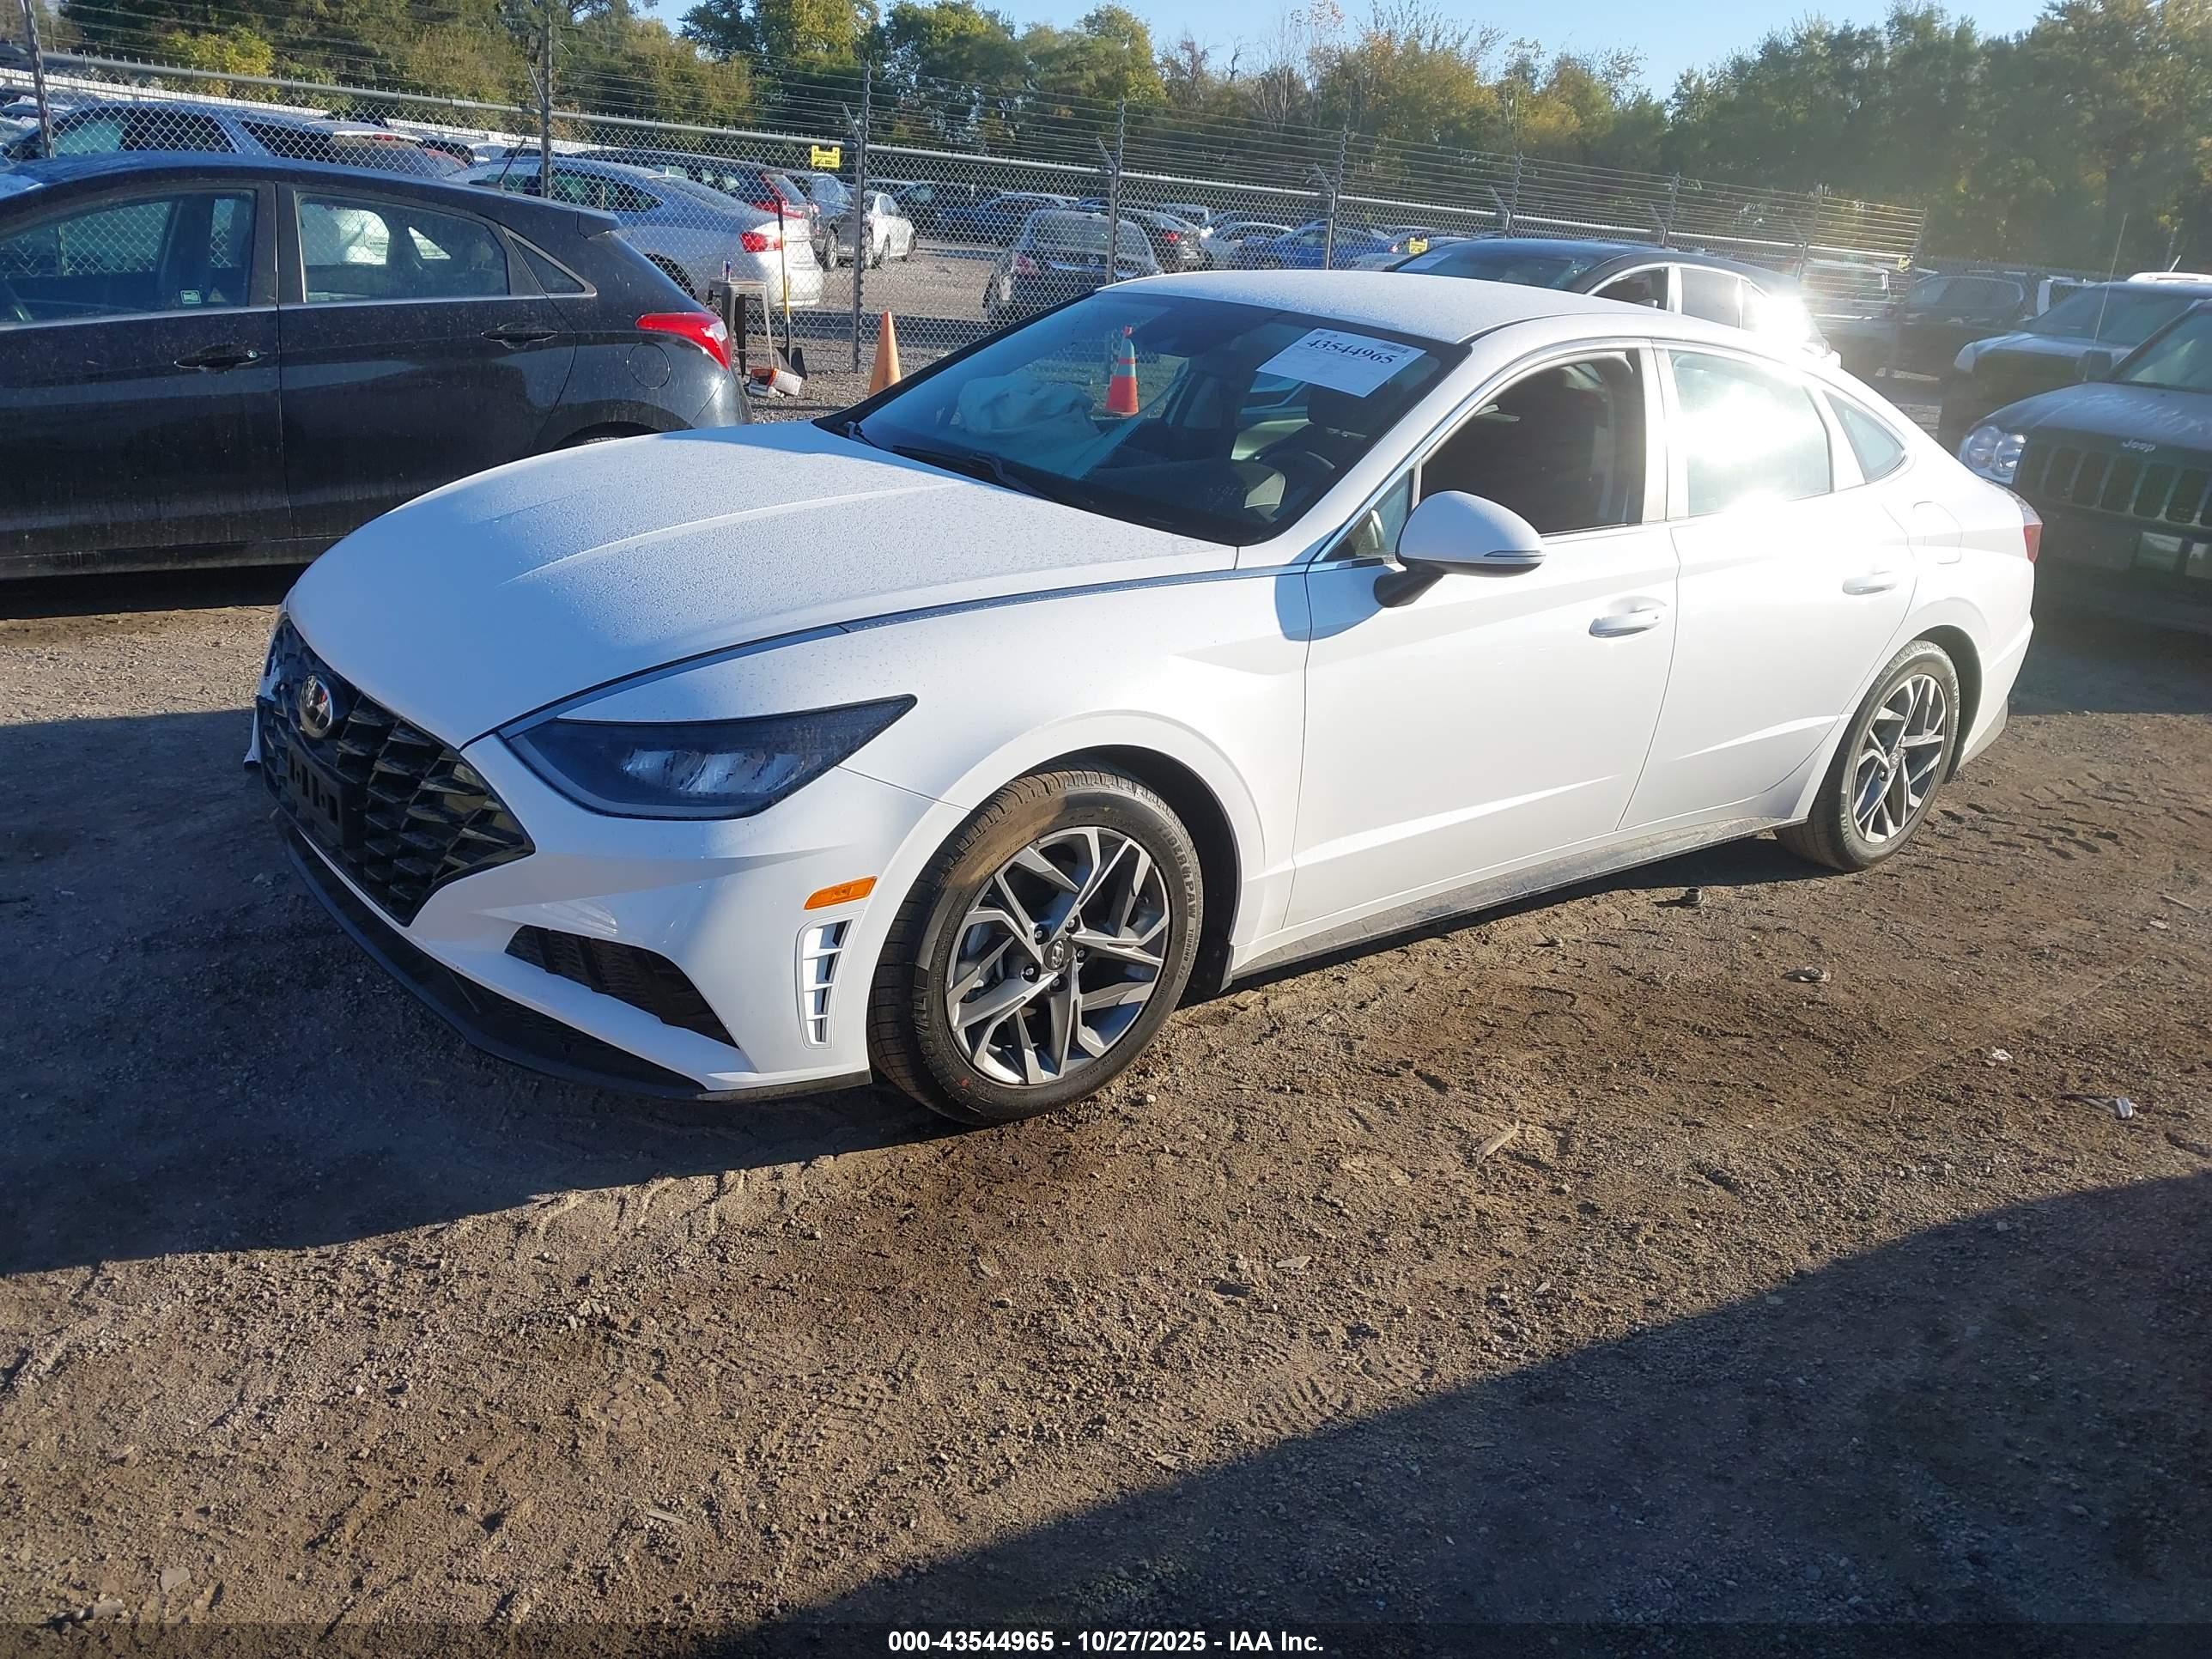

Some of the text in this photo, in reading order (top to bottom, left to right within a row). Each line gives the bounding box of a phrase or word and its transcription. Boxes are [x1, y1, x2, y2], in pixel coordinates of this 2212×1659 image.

[1307, 338, 1398, 364] 43544965
[2121, 439, 2157, 453] Jeep
[1185, 880, 1197, 920] PAW
